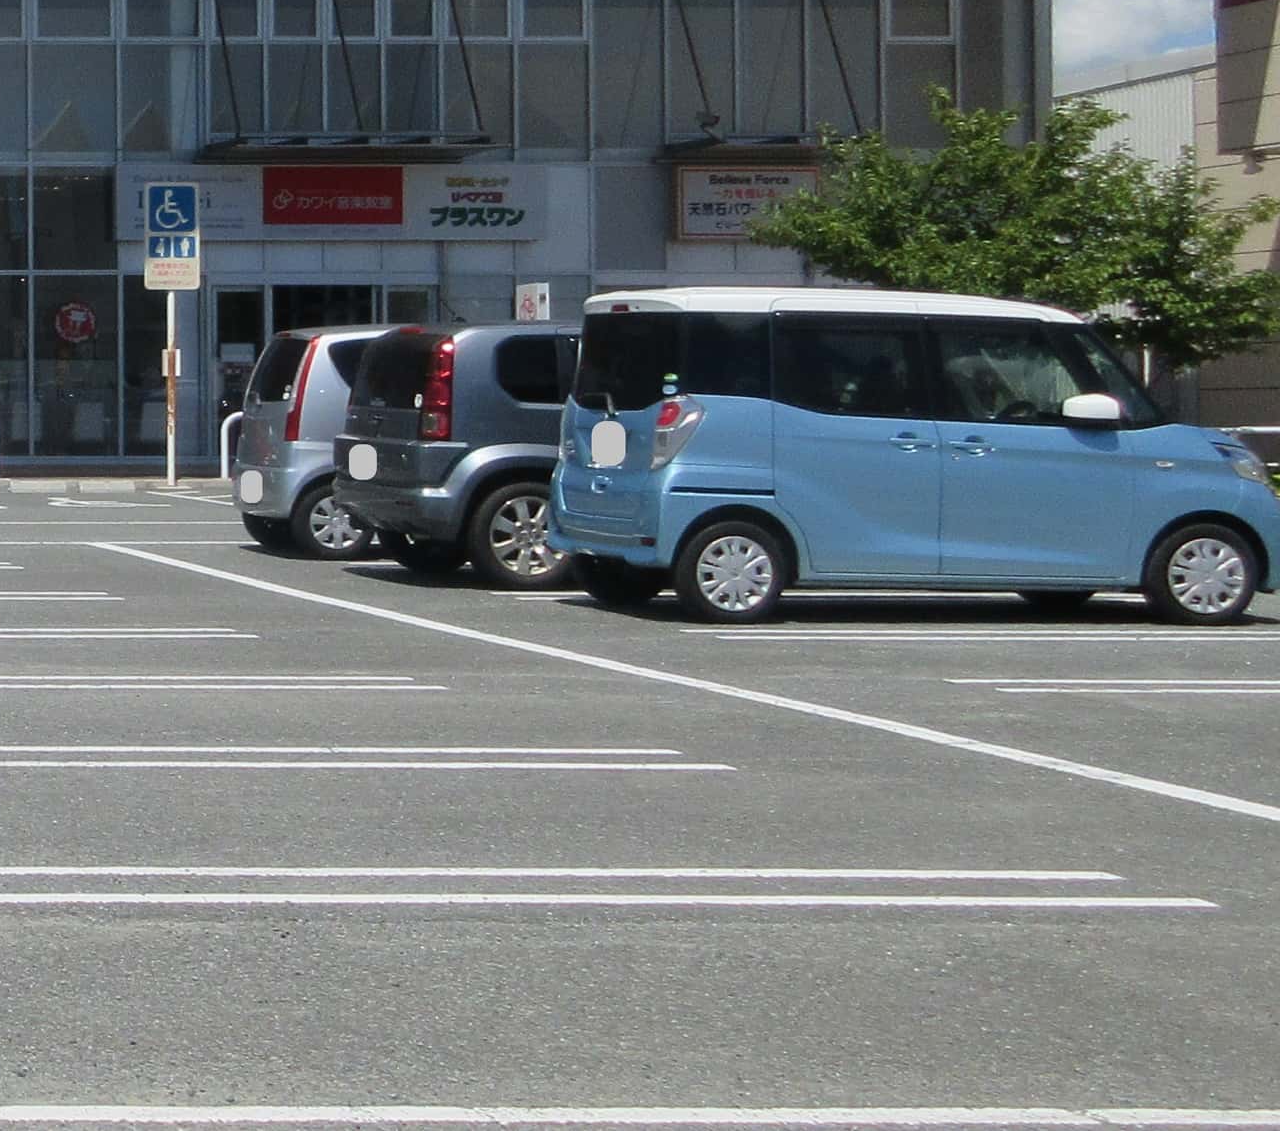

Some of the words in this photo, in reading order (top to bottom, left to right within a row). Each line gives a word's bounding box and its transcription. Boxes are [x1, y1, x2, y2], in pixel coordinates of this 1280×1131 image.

[755, 174, 789, 185] Force
[297, 196, 393, 210] カワイ音楽教室
[429, 206, 526, 227] プラスワン
